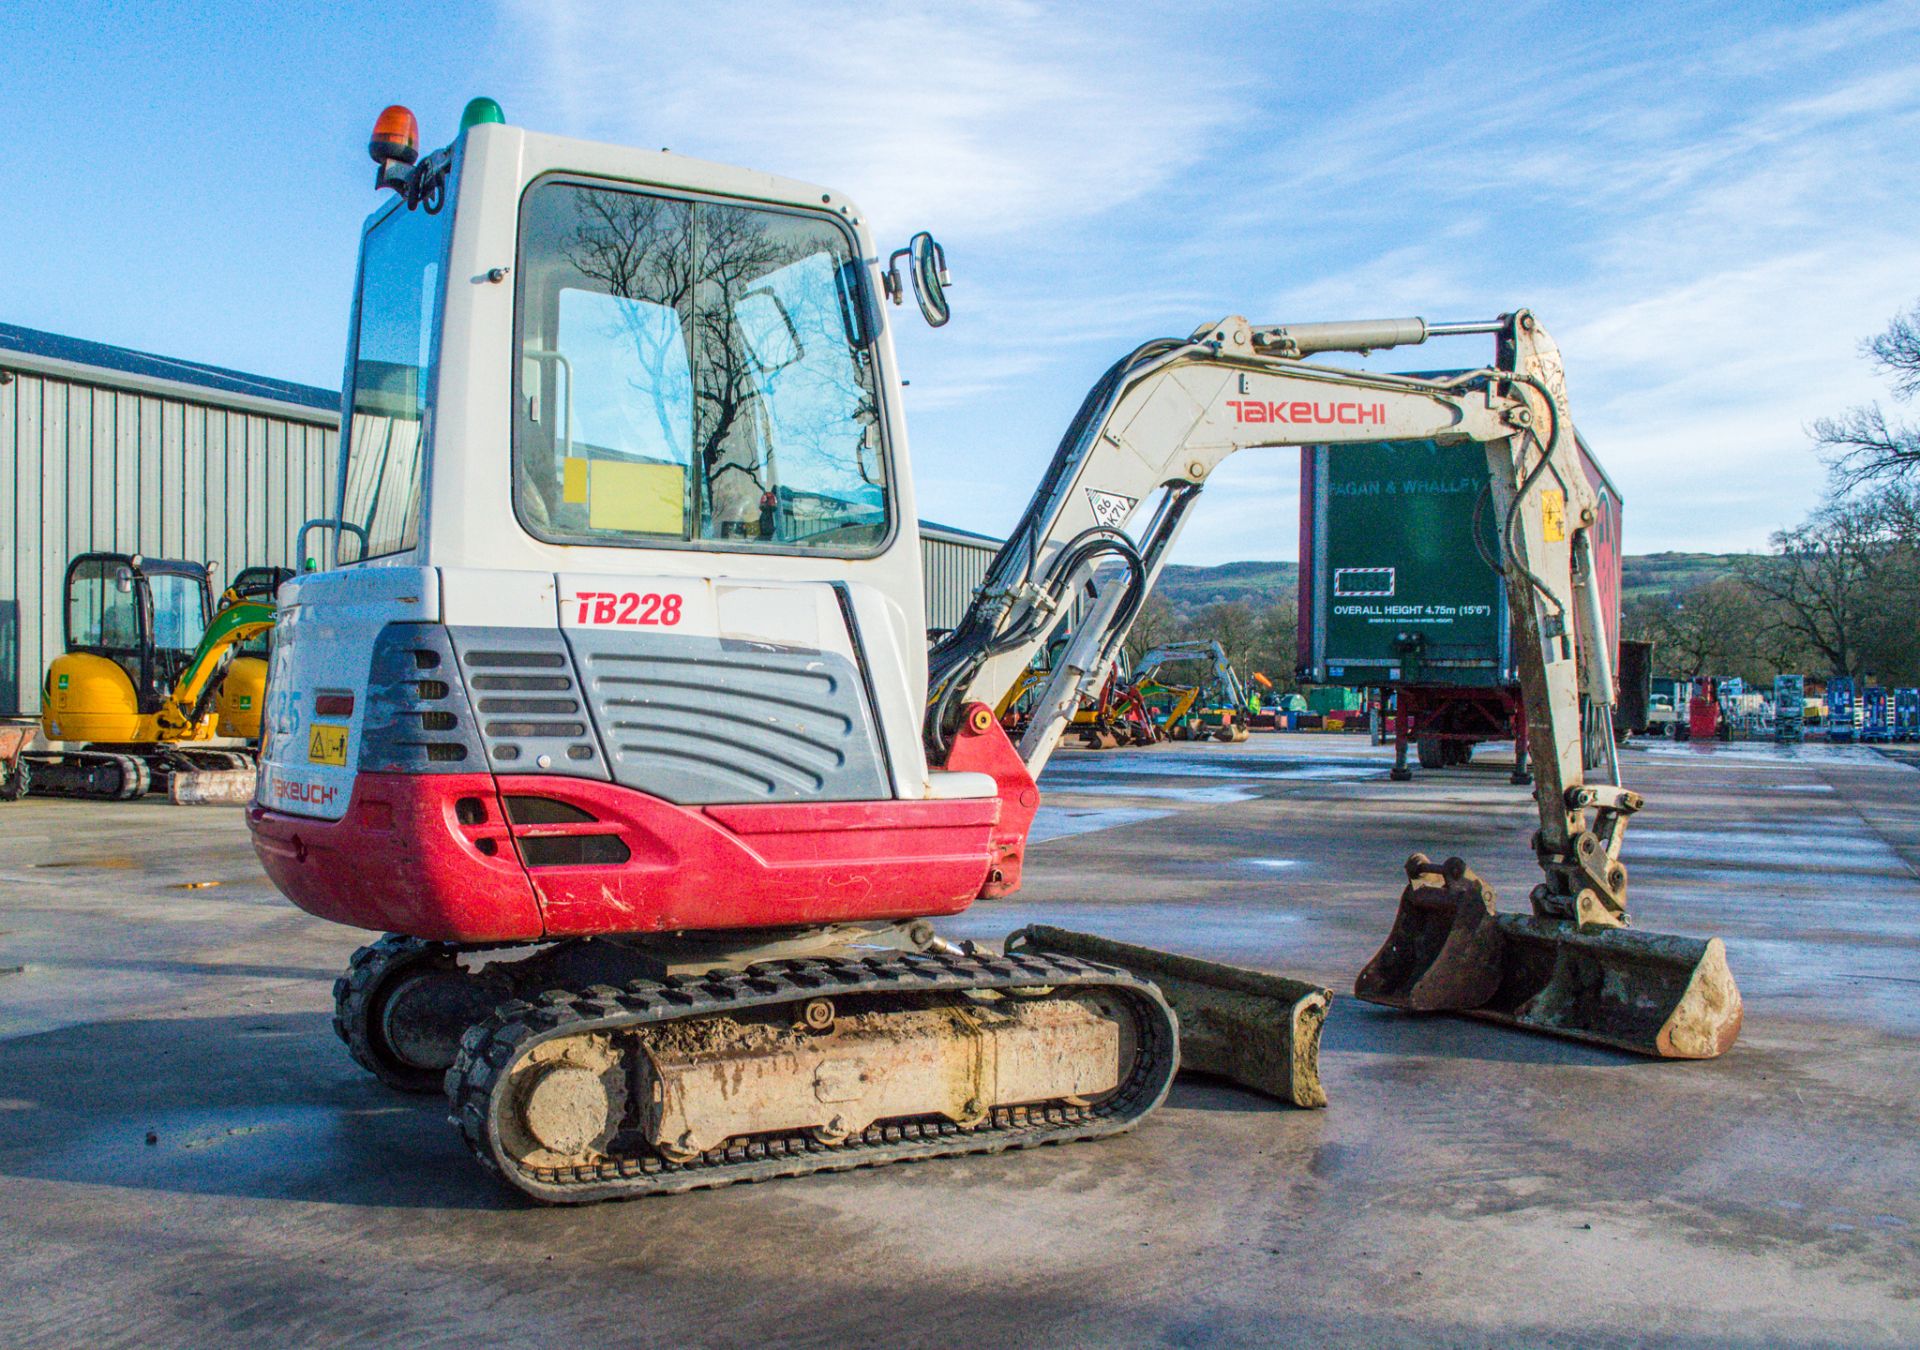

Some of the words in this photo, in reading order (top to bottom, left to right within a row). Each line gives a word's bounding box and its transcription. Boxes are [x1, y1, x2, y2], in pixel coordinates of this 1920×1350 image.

[576, 592, 683, 626] TB228
[1334, 605, 1382, 615] OVERALL
[1384, 605, 1423, 615] HEIGHT
[1425, 605, 1456, 615] 4.75m
